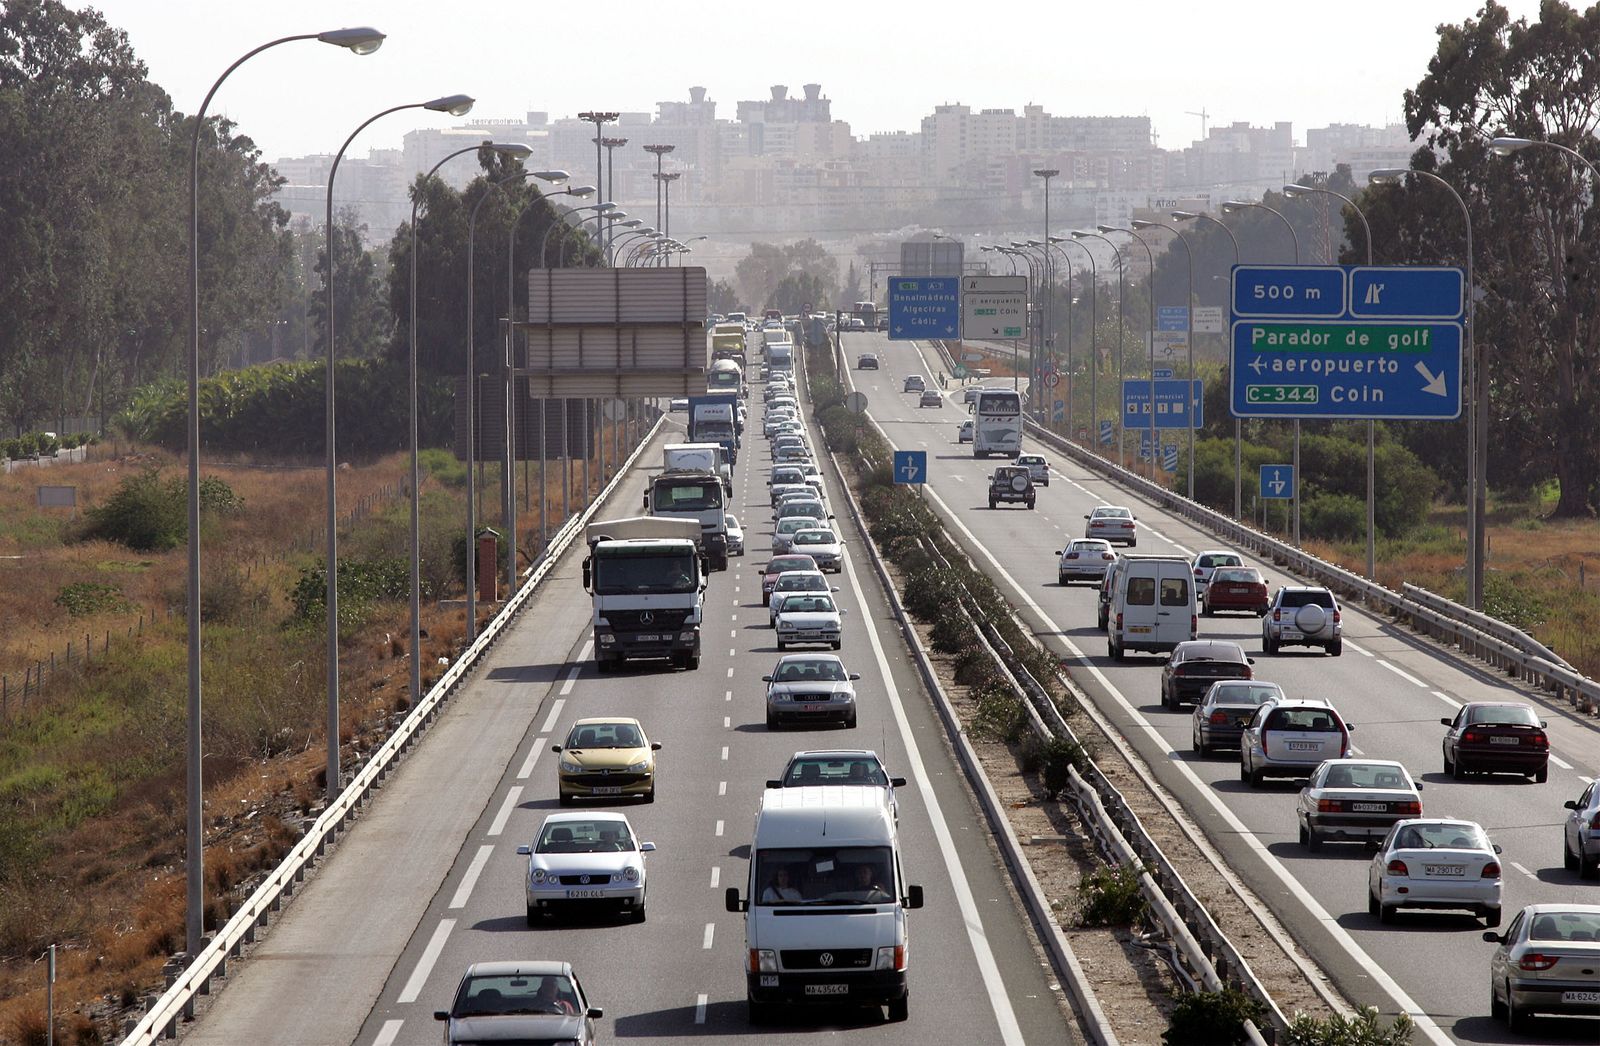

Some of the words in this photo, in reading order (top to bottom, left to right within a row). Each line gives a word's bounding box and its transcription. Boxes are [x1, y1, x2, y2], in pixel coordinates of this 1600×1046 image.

[1254, 285, 1294, 299] 500
[1305, 288, 1320, 299] m
[902, 306, 946, 314] Algeciras
[1252, 328, 1331, 345] Parador
[1346, 330, 1370, 346] de
[1388, 330, 1430, 350] golf
[1272, 358, 1399, 376] aeropuerto
[1248, 388, 1316, 402] C-344
